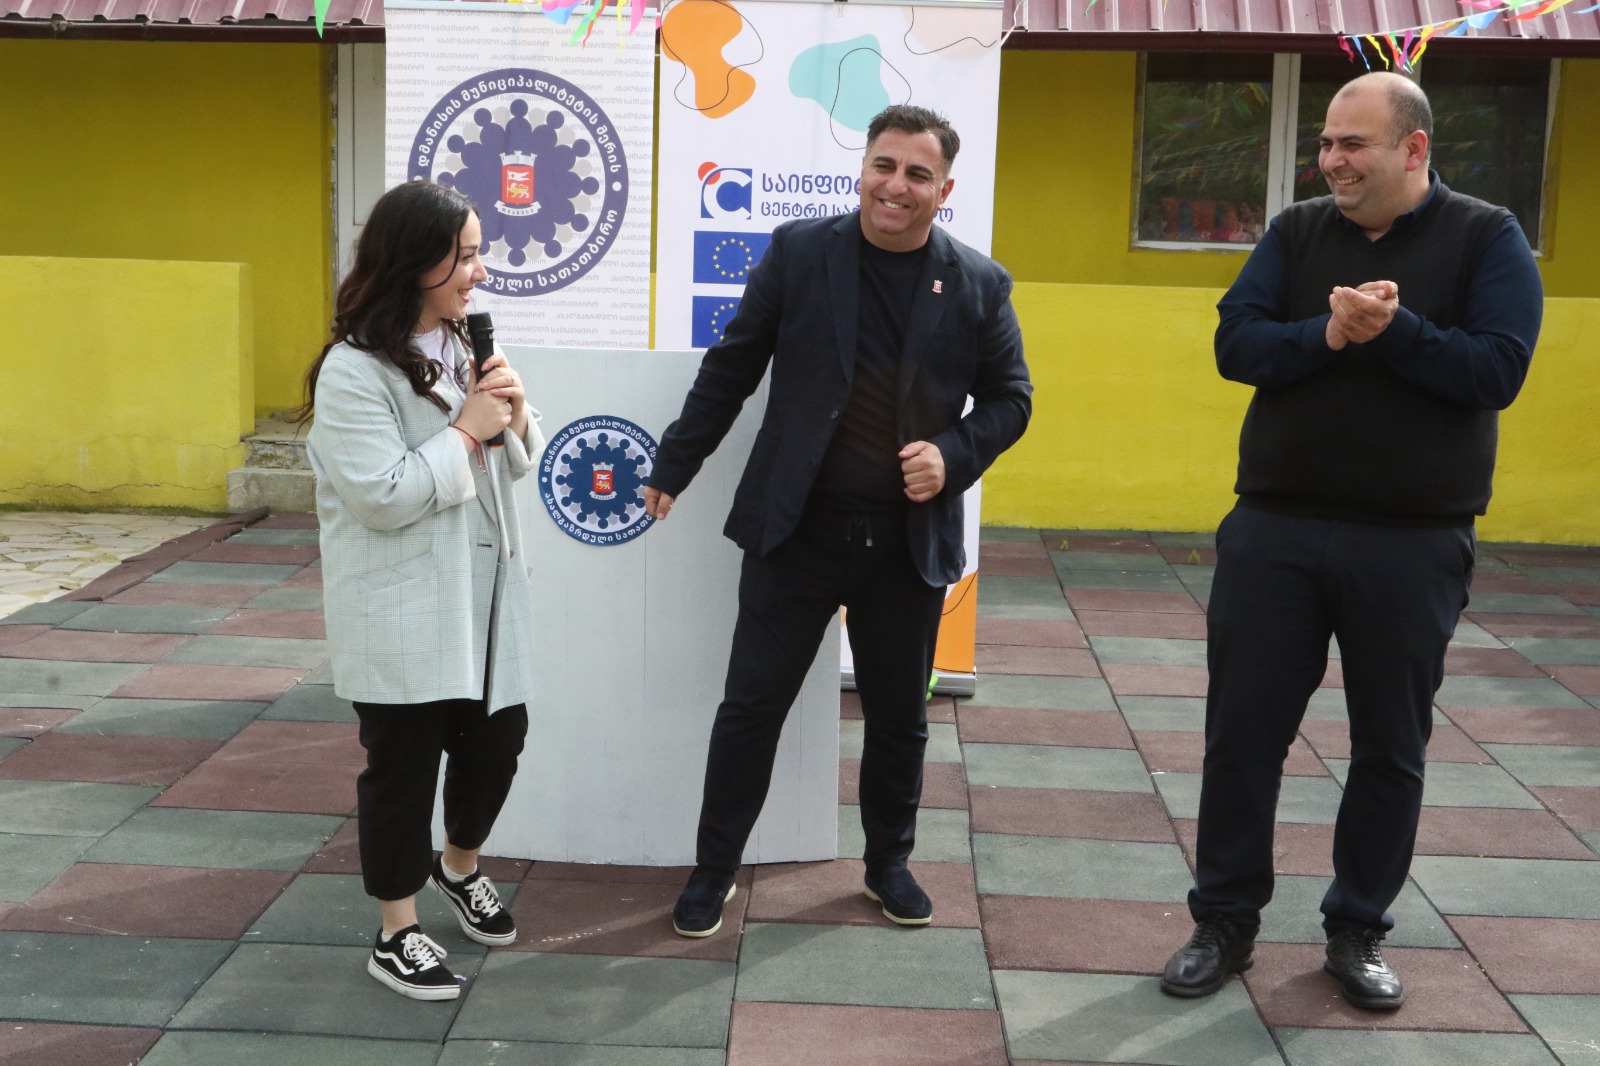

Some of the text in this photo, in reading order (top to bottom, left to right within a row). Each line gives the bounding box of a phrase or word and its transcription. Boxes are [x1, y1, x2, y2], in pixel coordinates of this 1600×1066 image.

[418, 75, 622, 173] დმანისის მუნიციპალიტეტის მერის
[761, 201, 827, 218] ცენტრი
[537, 210, 618, 287] სათათბირო
[544, 419, 651, 473] დმანისის მუნიციპალიტეტის
[544, 493, 653, 543] ახალგაზრდული სათათბ
